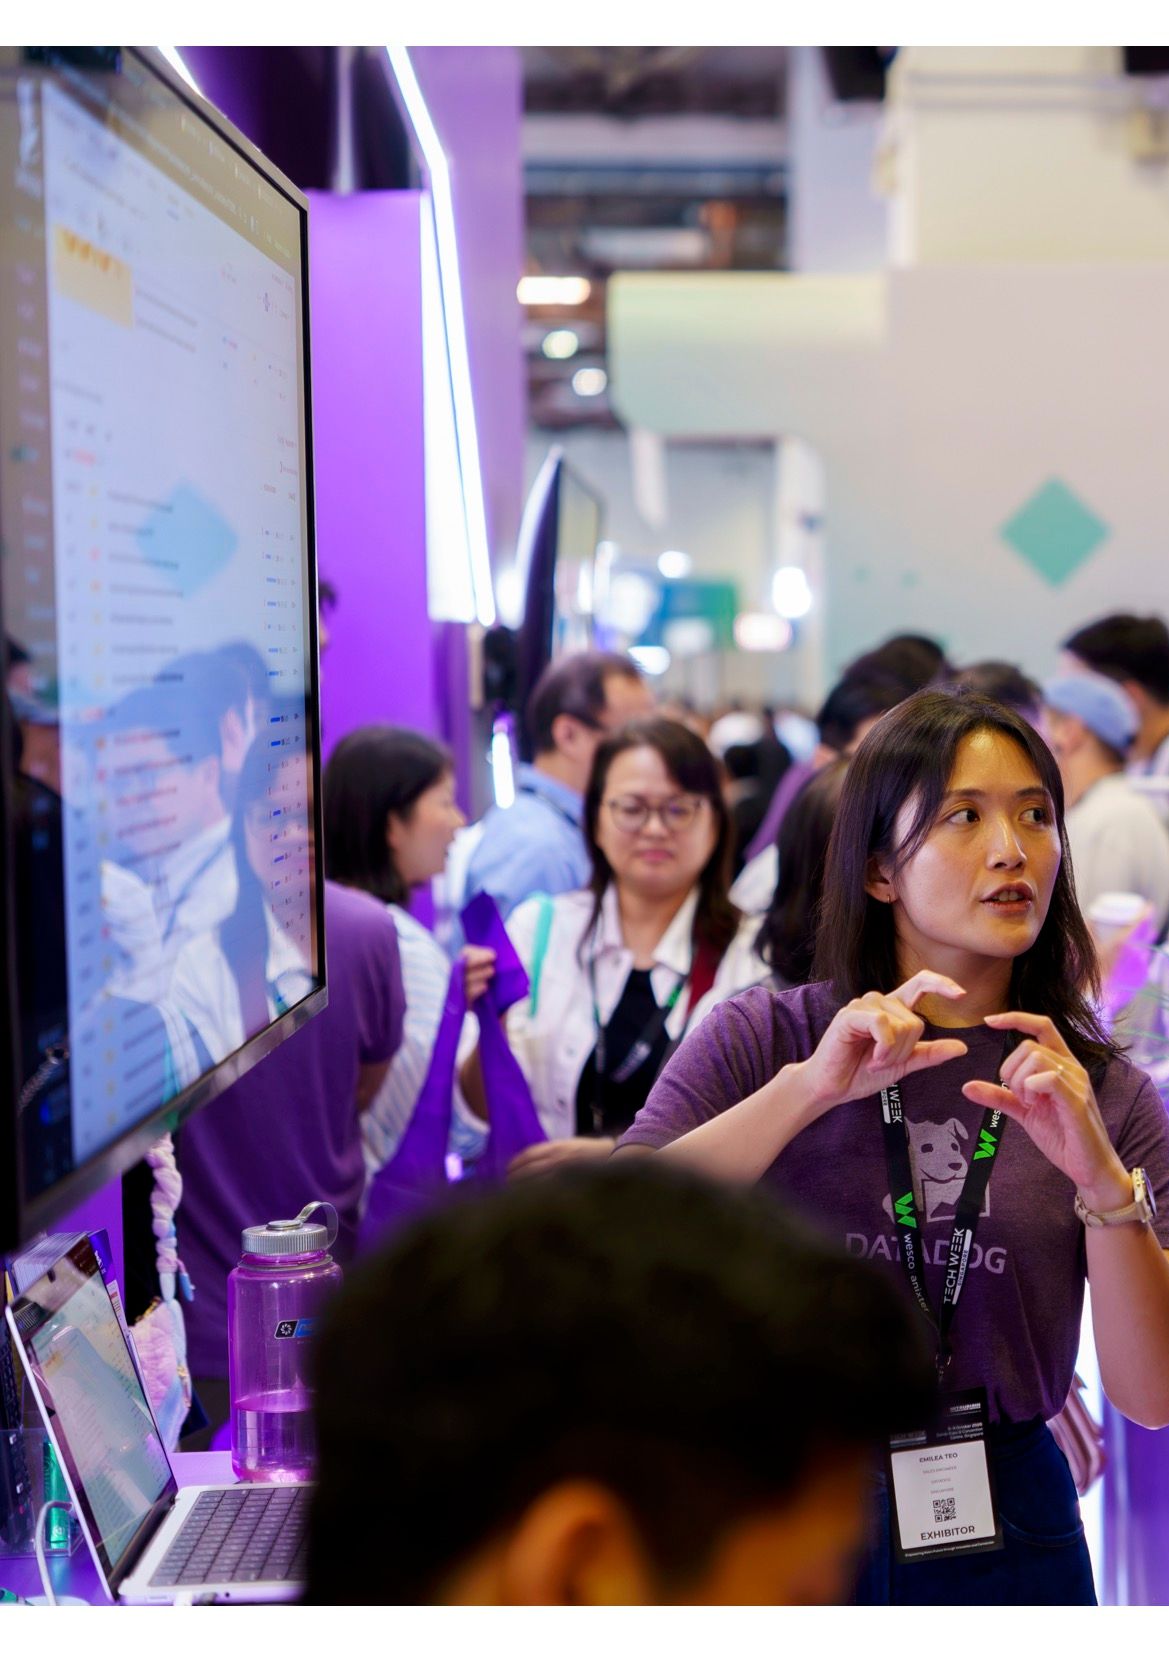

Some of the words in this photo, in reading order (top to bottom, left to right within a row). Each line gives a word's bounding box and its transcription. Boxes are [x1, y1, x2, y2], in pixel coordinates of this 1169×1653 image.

[889, 1089, 903, 1123] WEEK
[989, 1109, 1002, 1128] wes
[845, 1231, 1008, 1275] DAADOG
[949, 1227, 966, 1267] WEEK
[903, 1233, 916, 1270] wesco
[911, 1275, 930, 1313] anixter
[957, 1249, 970, 1287] SINGAPORE
[943, 1269, 958, 1305] TECH
[919, 1455, 943, 1463] EMILEA
[945, 1452, 959, 1460] TEO
[920, 1525, 976, 1541] EXHIBITOR
